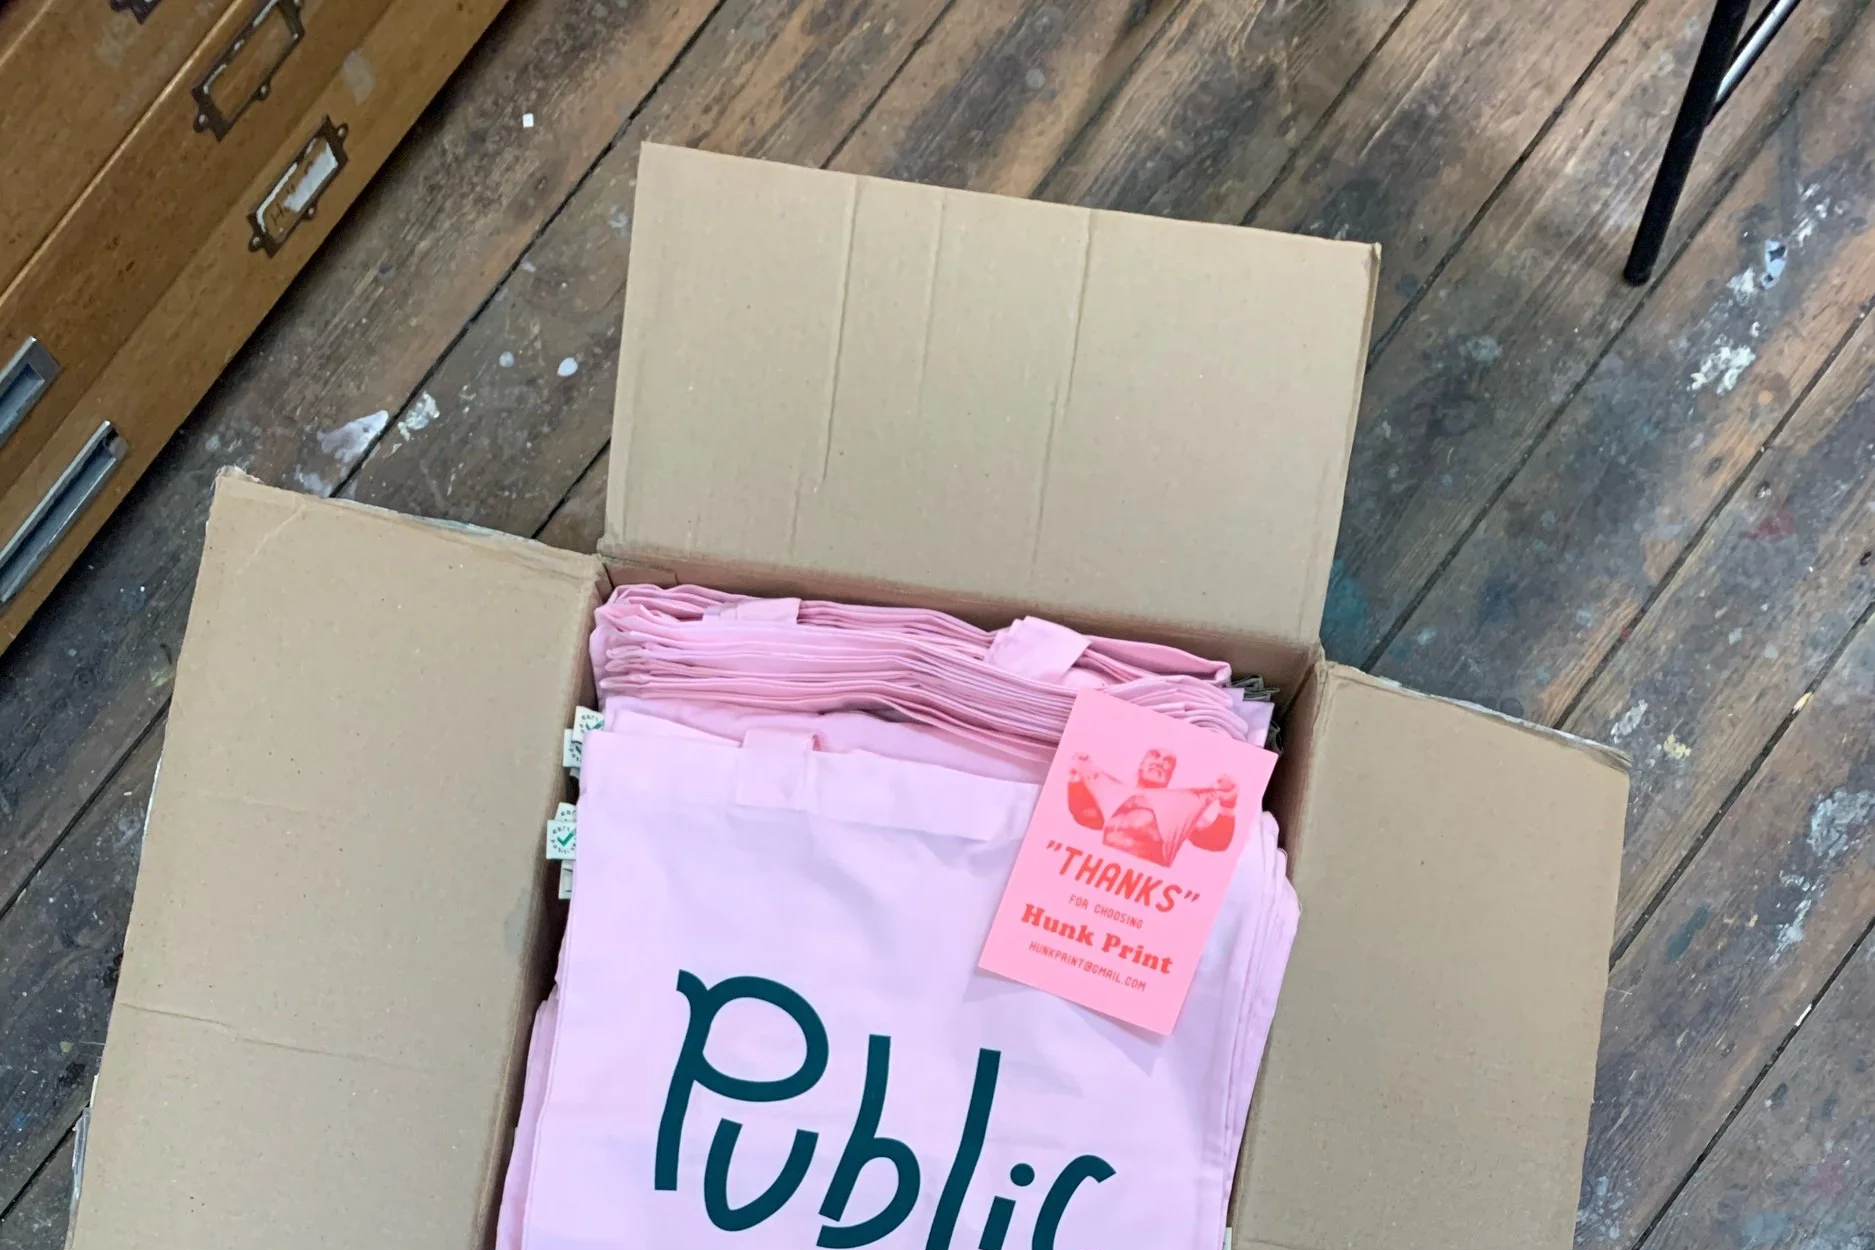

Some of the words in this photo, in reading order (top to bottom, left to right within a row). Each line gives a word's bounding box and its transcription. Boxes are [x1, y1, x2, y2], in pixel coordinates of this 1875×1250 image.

[1068, 894, 1089, 909] FOR
[1094, 903, 1144, 930] CHOOSING
[1020, 904, 1093, 947] Hunk
[1101, 932, 1173, 974] Print
[1029, 942, 1146, 992] HUNKPRINT@GMAIL.COM
